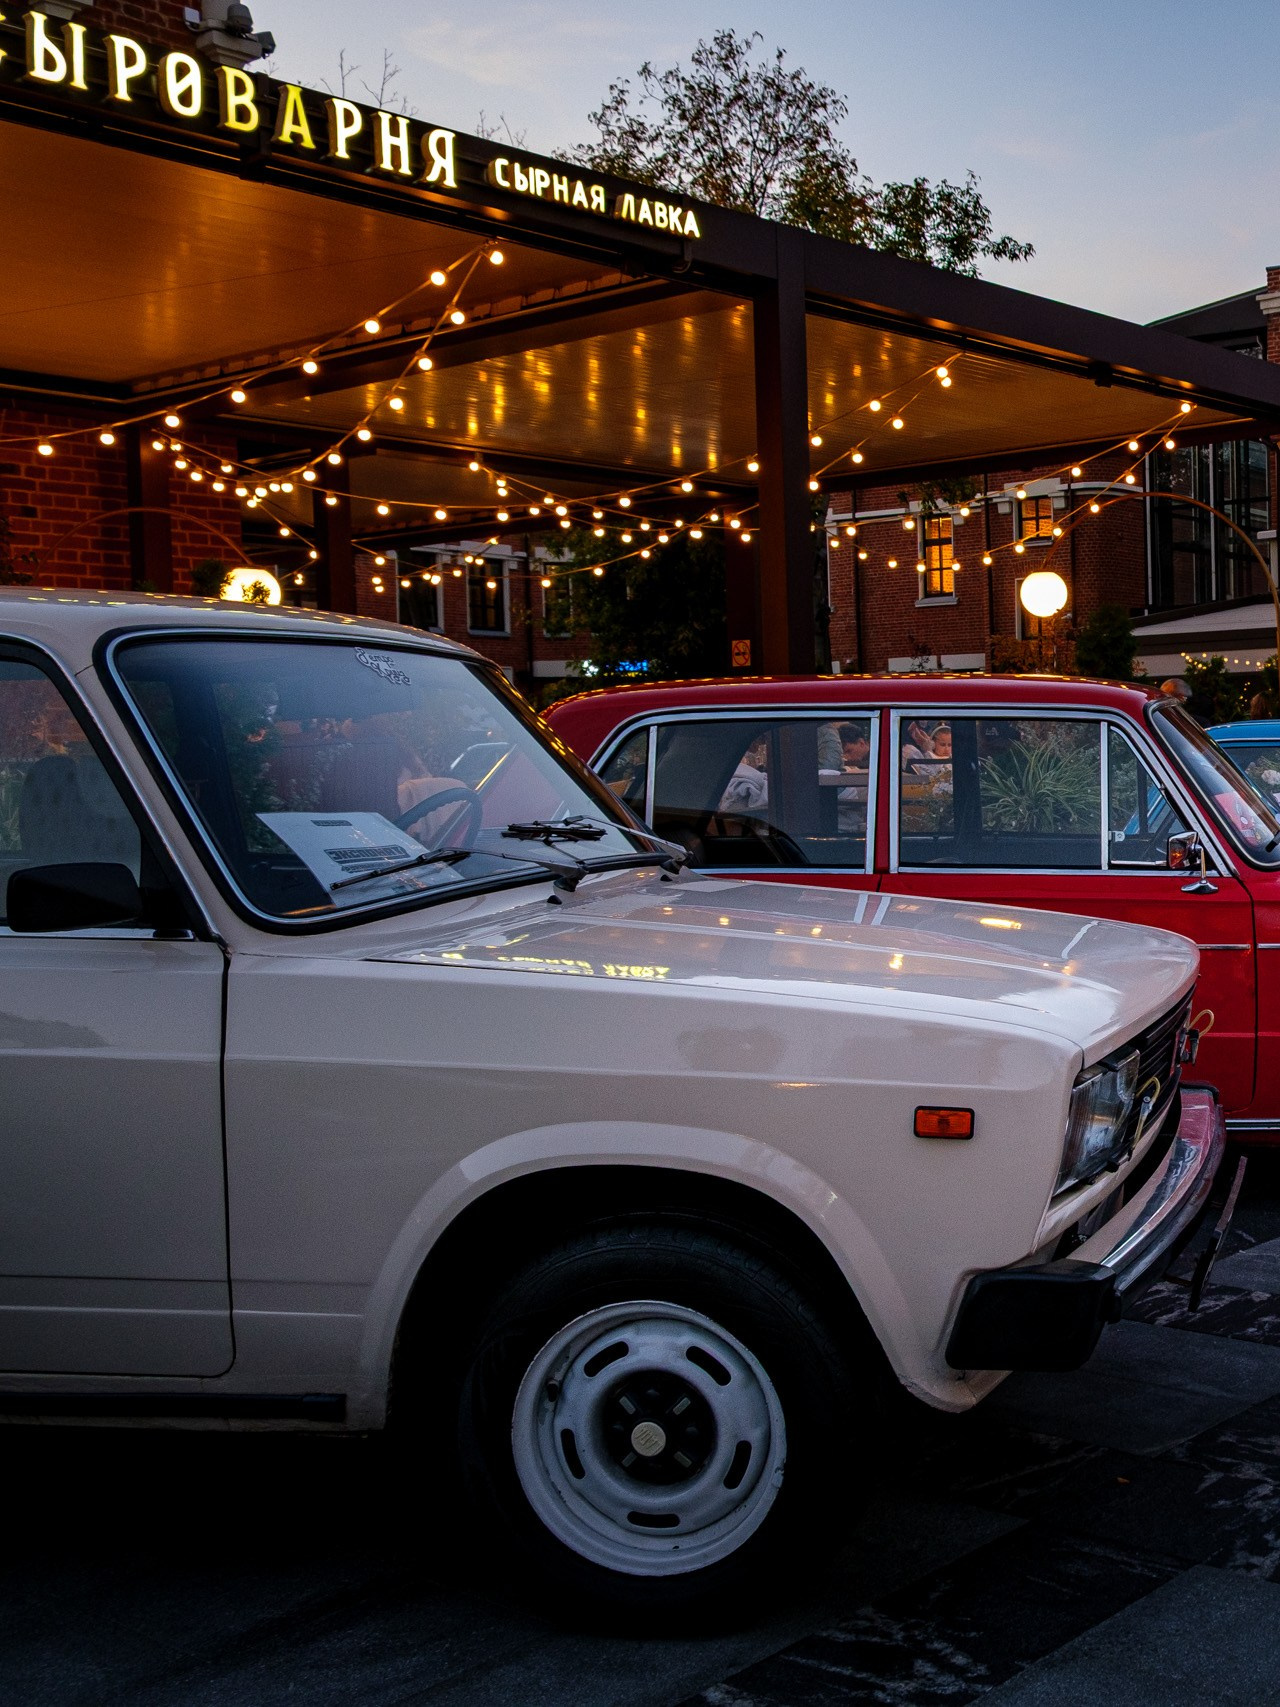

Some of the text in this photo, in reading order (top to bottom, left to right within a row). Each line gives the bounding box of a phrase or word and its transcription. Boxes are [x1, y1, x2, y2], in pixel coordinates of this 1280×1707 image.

[0, 10, 459, 188] ЫРОВАРНЯ
[493, 157, 701, 238] СЫРНАЯ ЛАВКА
